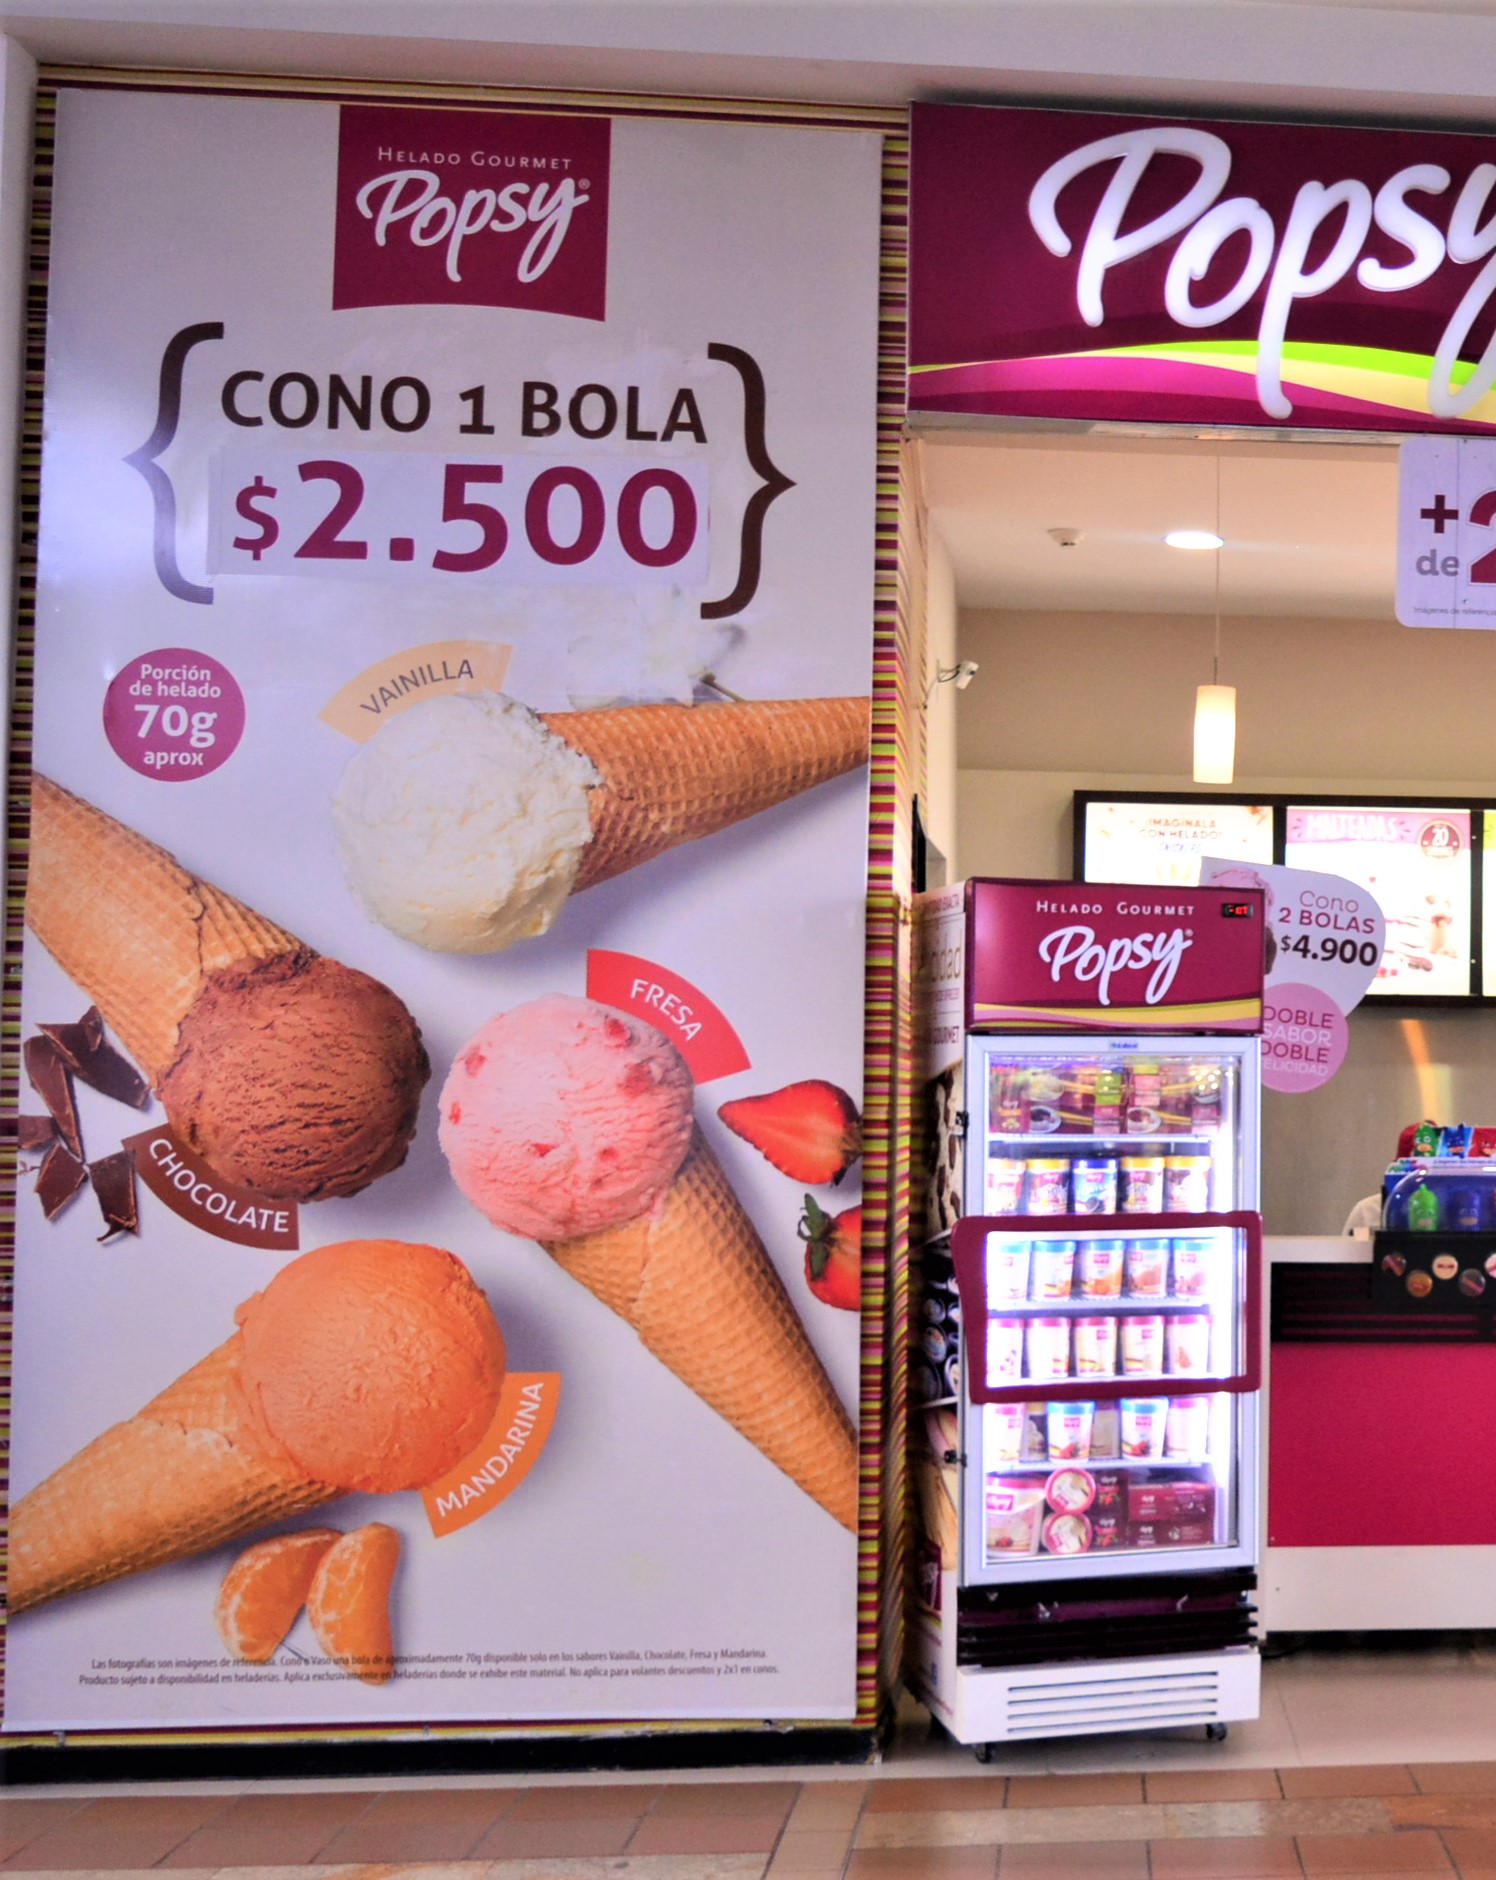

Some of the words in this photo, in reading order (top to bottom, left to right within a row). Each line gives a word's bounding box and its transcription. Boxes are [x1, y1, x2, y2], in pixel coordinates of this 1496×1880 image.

[378, 147, 461, 166] HELADO
[471, 150, 572, 171] GOURMET
[356, 169, 589, 283] Popsy
[221, 370, 431, 434] CONO
[459, 386, 495, 434] 1
[521, 381, 707, 444] BOLA
[233, 459, 698, 573] $2.500
[1415, 548, 1460, 578] de
[140, 663, 211, 682] Porción
[359, 659, 474, 715] VAINILLA
[129, 680, 153, 696] de
[157, 680, 222, 698] helado
[134, 704, 218, 748] 70g
[143, 750, 204, 768] aprox
[1036, 900, 1103, 915] HELADO
[1117, 901, 1194, 916] GOURMET
[1300, 890, 1359, 914] Cono
[1278, 907, 1291, 924] 2
[1299, 910, 1375, 935] BOLAS
[1038, 925, 1193, 1006] Popsy
[1280, 933, 1378, 967] $4.900
[630, 977, 703, 1042] FRESA
[1264, 1058, 1328, 1076] ELICIDAD
[149, 1138, 290, 1233] CHOCOLATE
[436, 1382, 544, 1517] MANDARINA
[92, 1659, 106, 1669] Las
